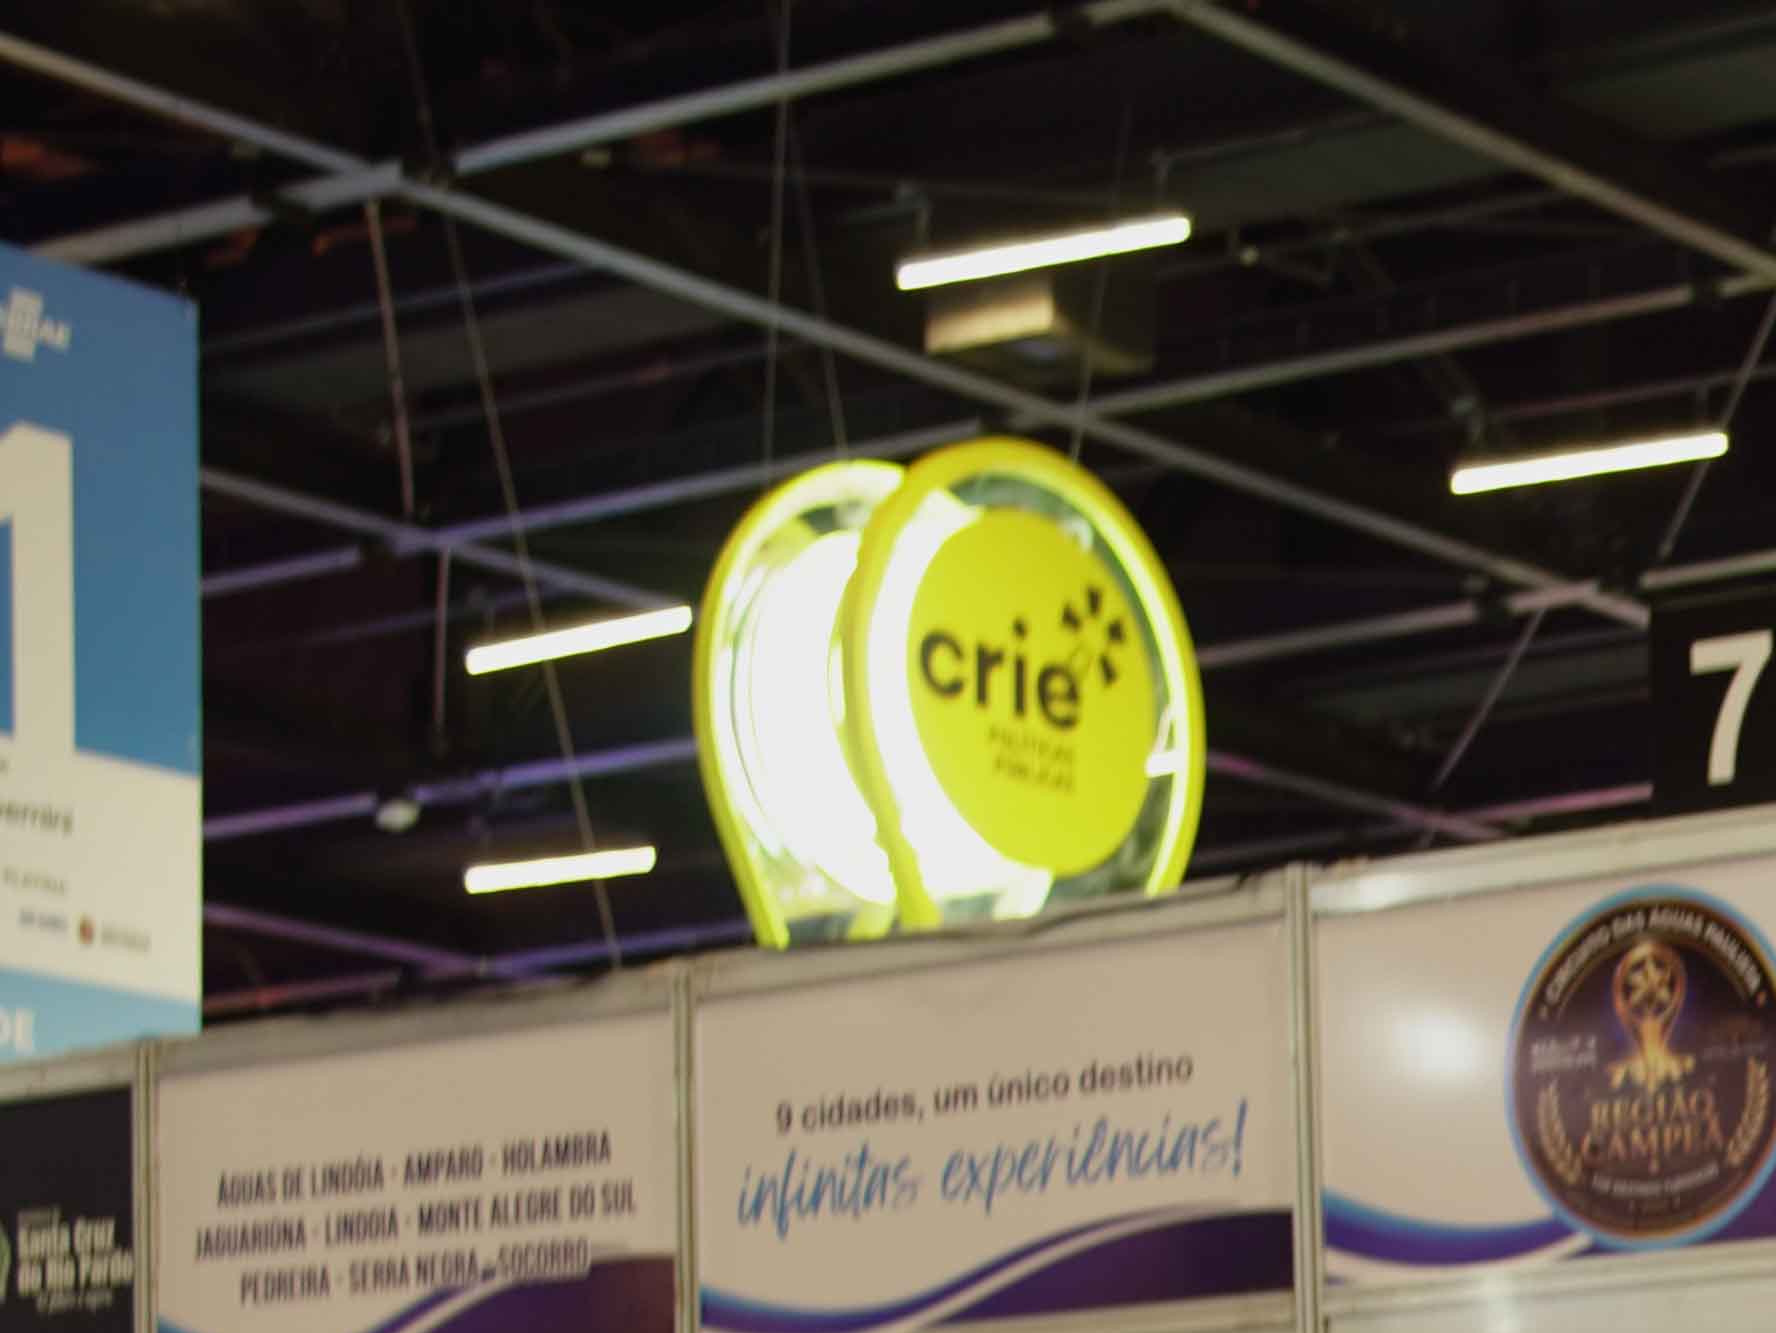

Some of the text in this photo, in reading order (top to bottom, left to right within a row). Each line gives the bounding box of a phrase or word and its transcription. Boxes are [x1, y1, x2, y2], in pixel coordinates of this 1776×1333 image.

[918, 616, 1082, 732] crie
[776, 1053, 1195, 1135] 9 cidades, um único destino
[403, 1143, 483, 1184] AMPARO
[738, 1098, 1250, 1243] infinitas experiências!
[418, 1196, 482, 1236] MONTE
